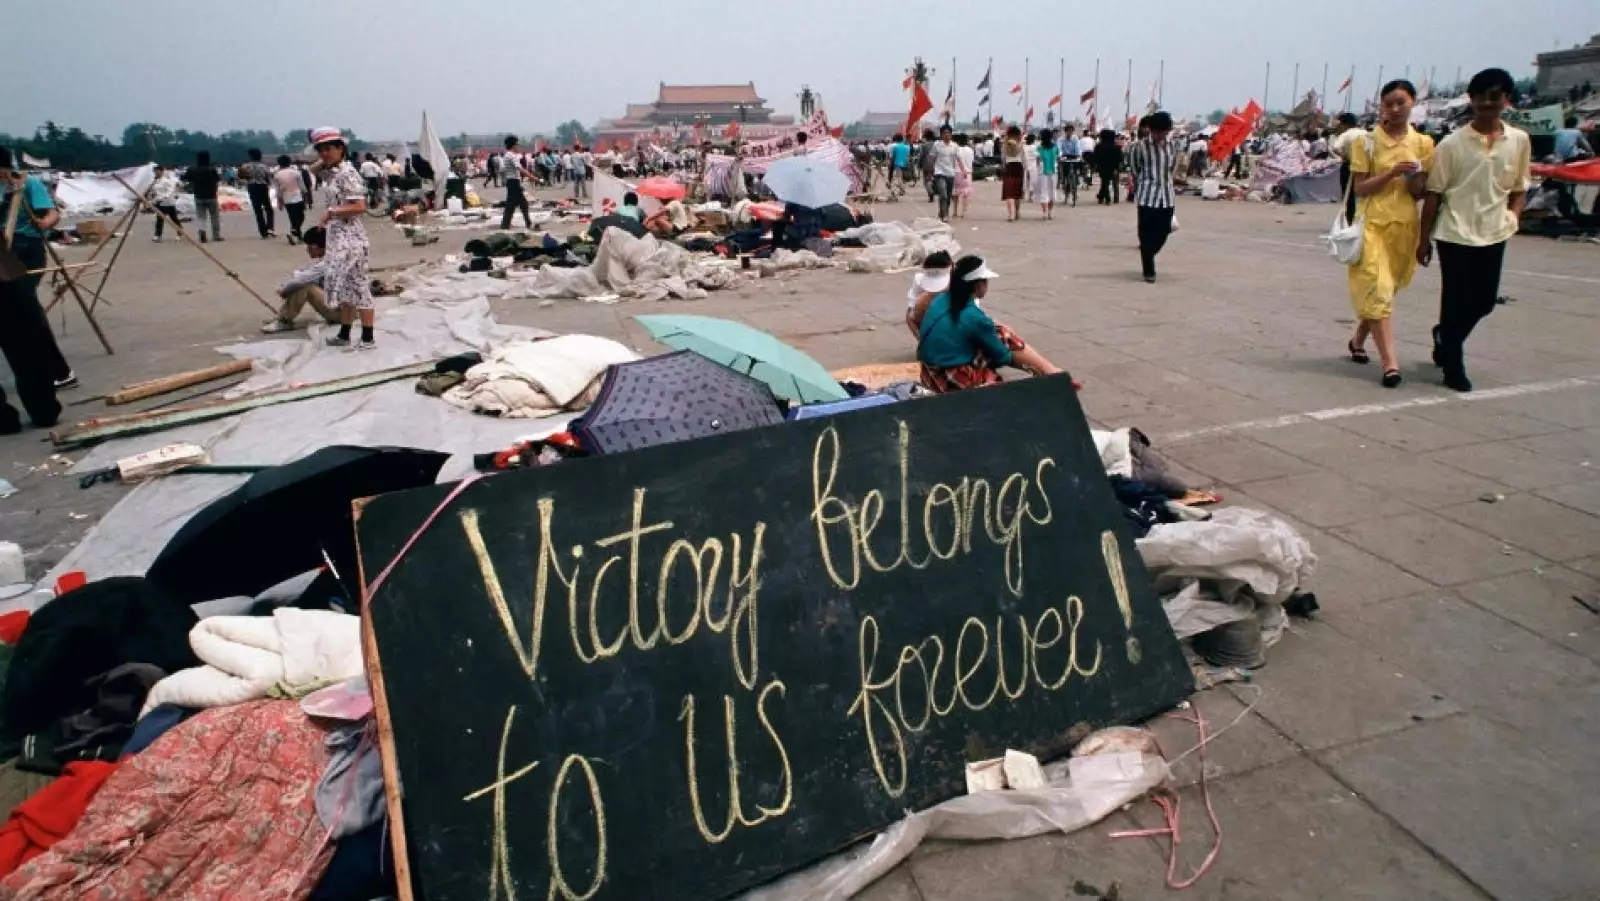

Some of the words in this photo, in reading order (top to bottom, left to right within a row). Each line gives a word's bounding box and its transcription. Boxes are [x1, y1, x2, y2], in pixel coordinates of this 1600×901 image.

[461, 487, 765, 688] Victory
[811, 419, 1056, 596] belongs
[462, 704, 607, 901] to
